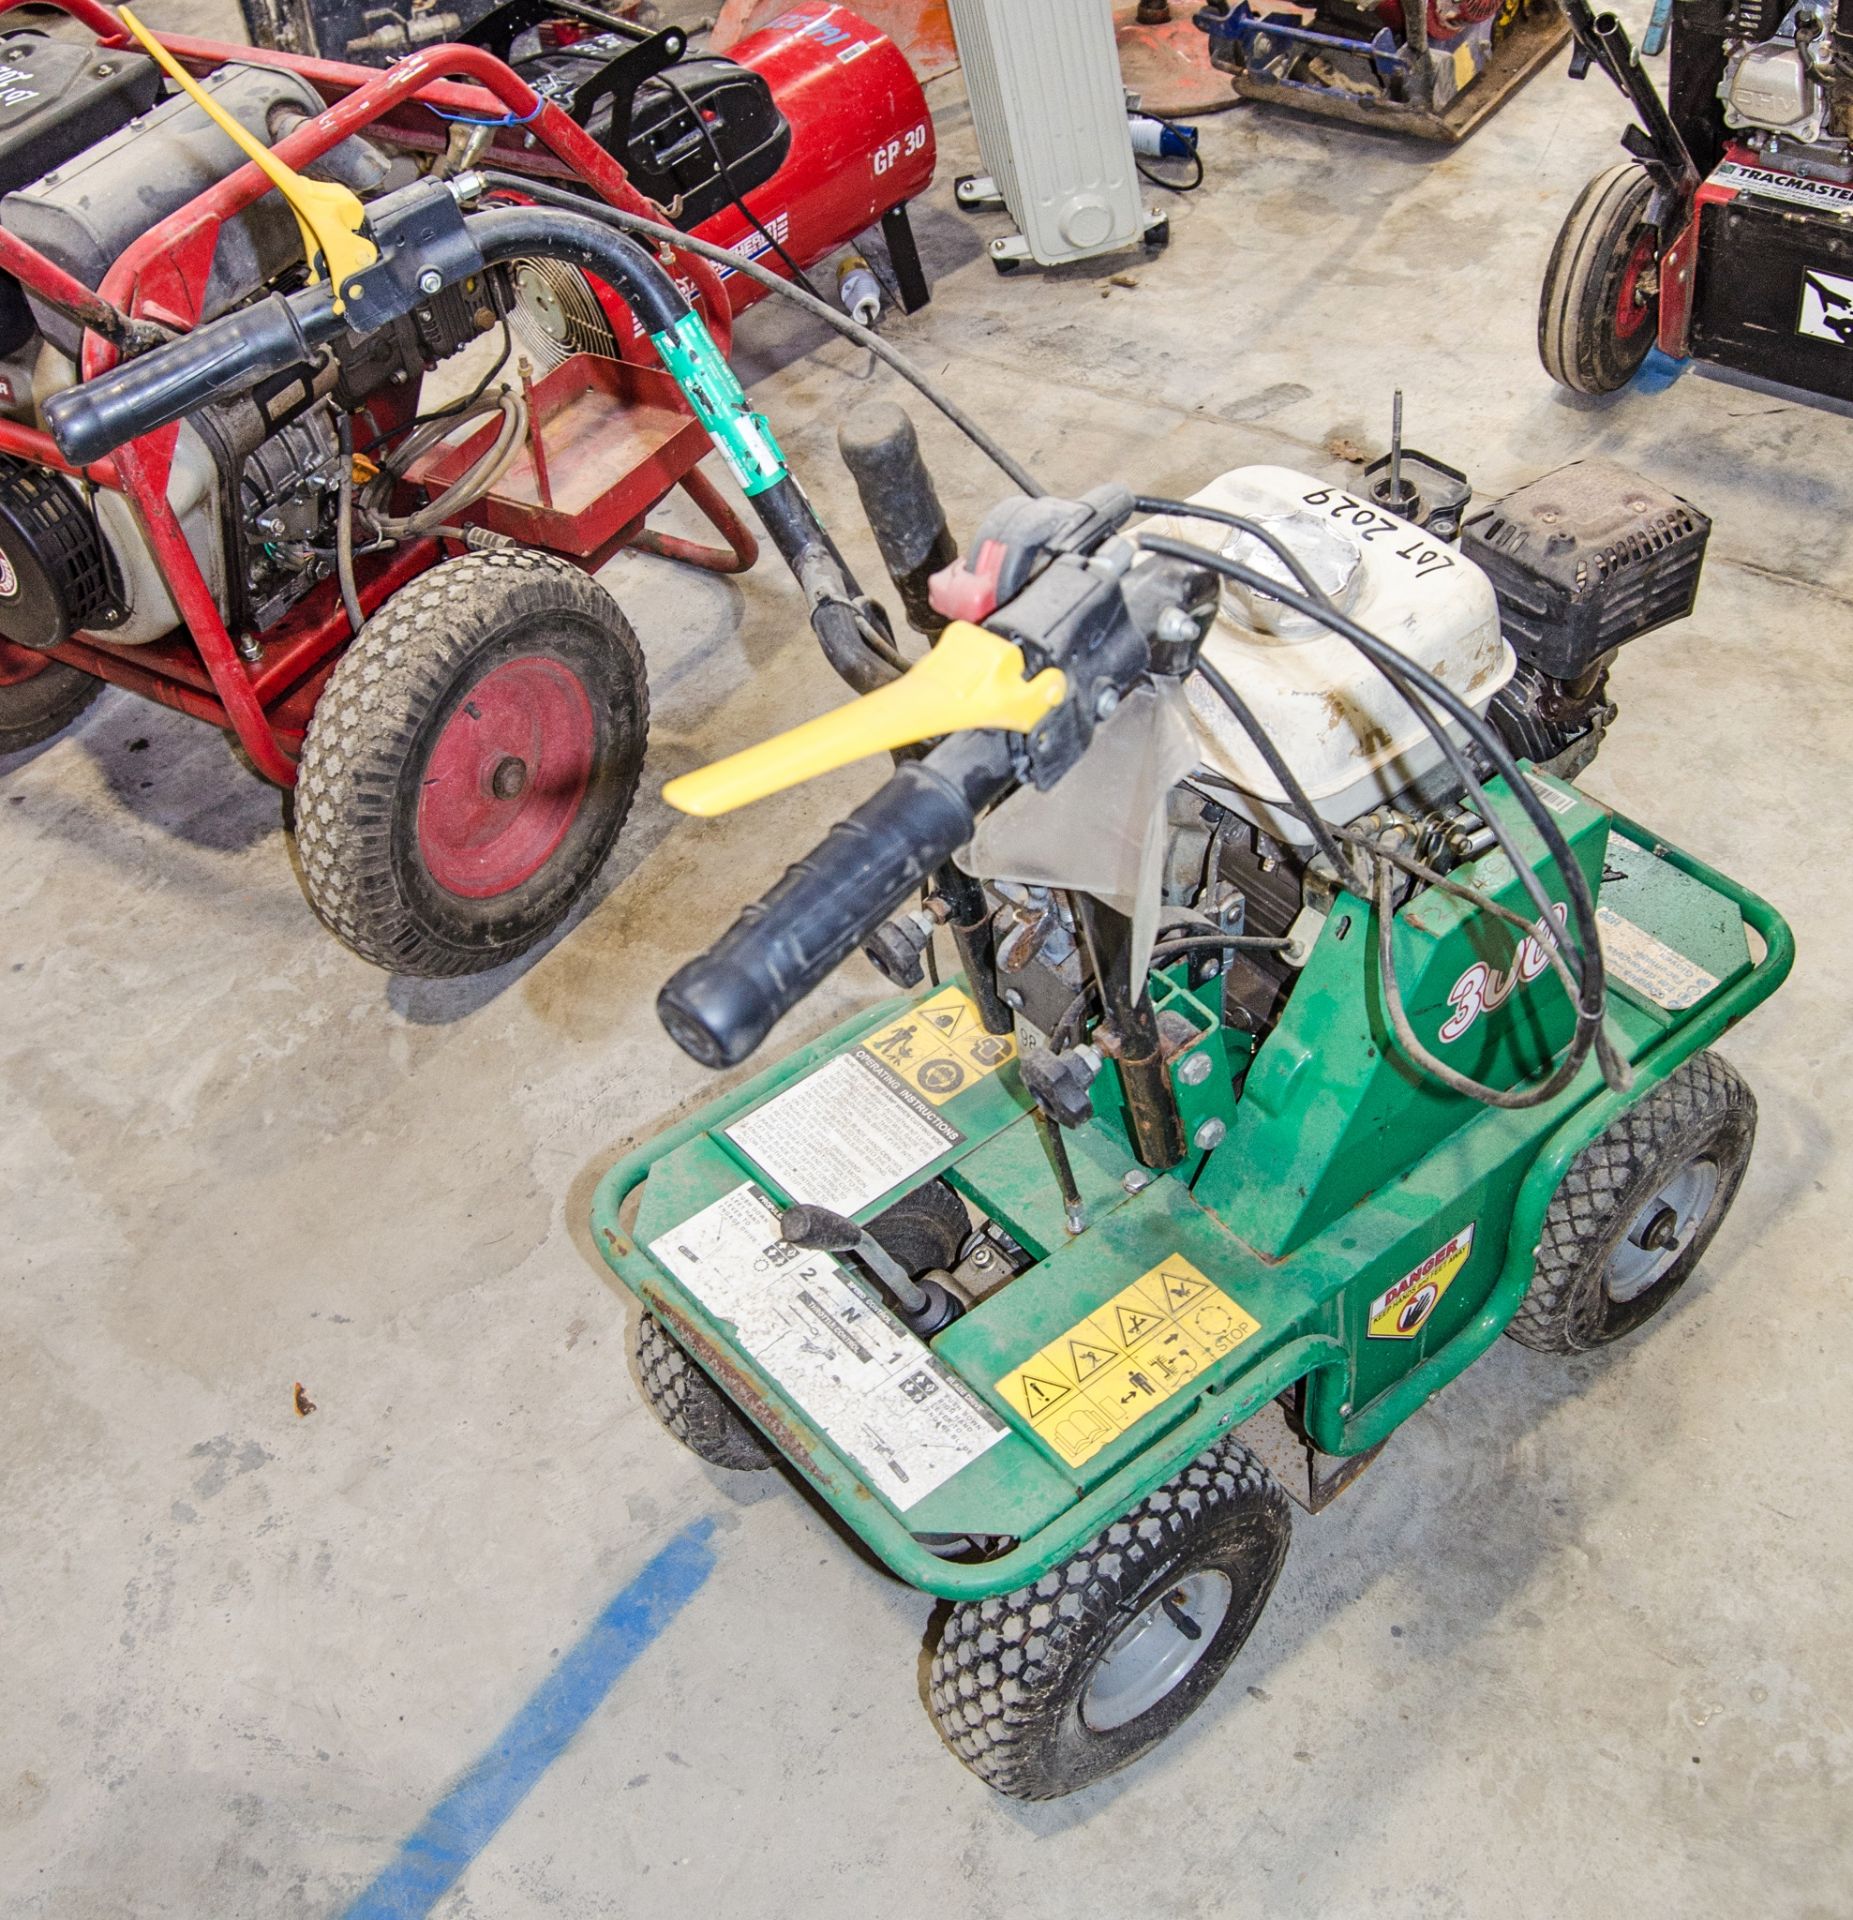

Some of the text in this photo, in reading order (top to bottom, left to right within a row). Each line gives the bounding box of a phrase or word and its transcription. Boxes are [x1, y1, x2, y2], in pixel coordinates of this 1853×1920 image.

[873, 125, 926, 175] GP 30
[1739, 167, 1853, 201] TRACMASTE
[1303, 487, 1456, 579] LOT 2029
[854, 1049, 902, 1089] OPERATING
[898, 1088, 959, 1140] INSTRUCTIONS
[741, 1217, 751, 1226] TO
[743, 1209, 761, 1225] HAND
[1384, 1239, 1458, 1307] DANGER
[799, 1266, 903, 1365] 2 N 1
[807, 1301, 861, 1353] THROTTLE CONTROL
[864, 1298, 892, 1324] CONTROL
[1215, 1322, 1249, 1352] STOP
[963, 1393, 984, 1411] DRIVE
